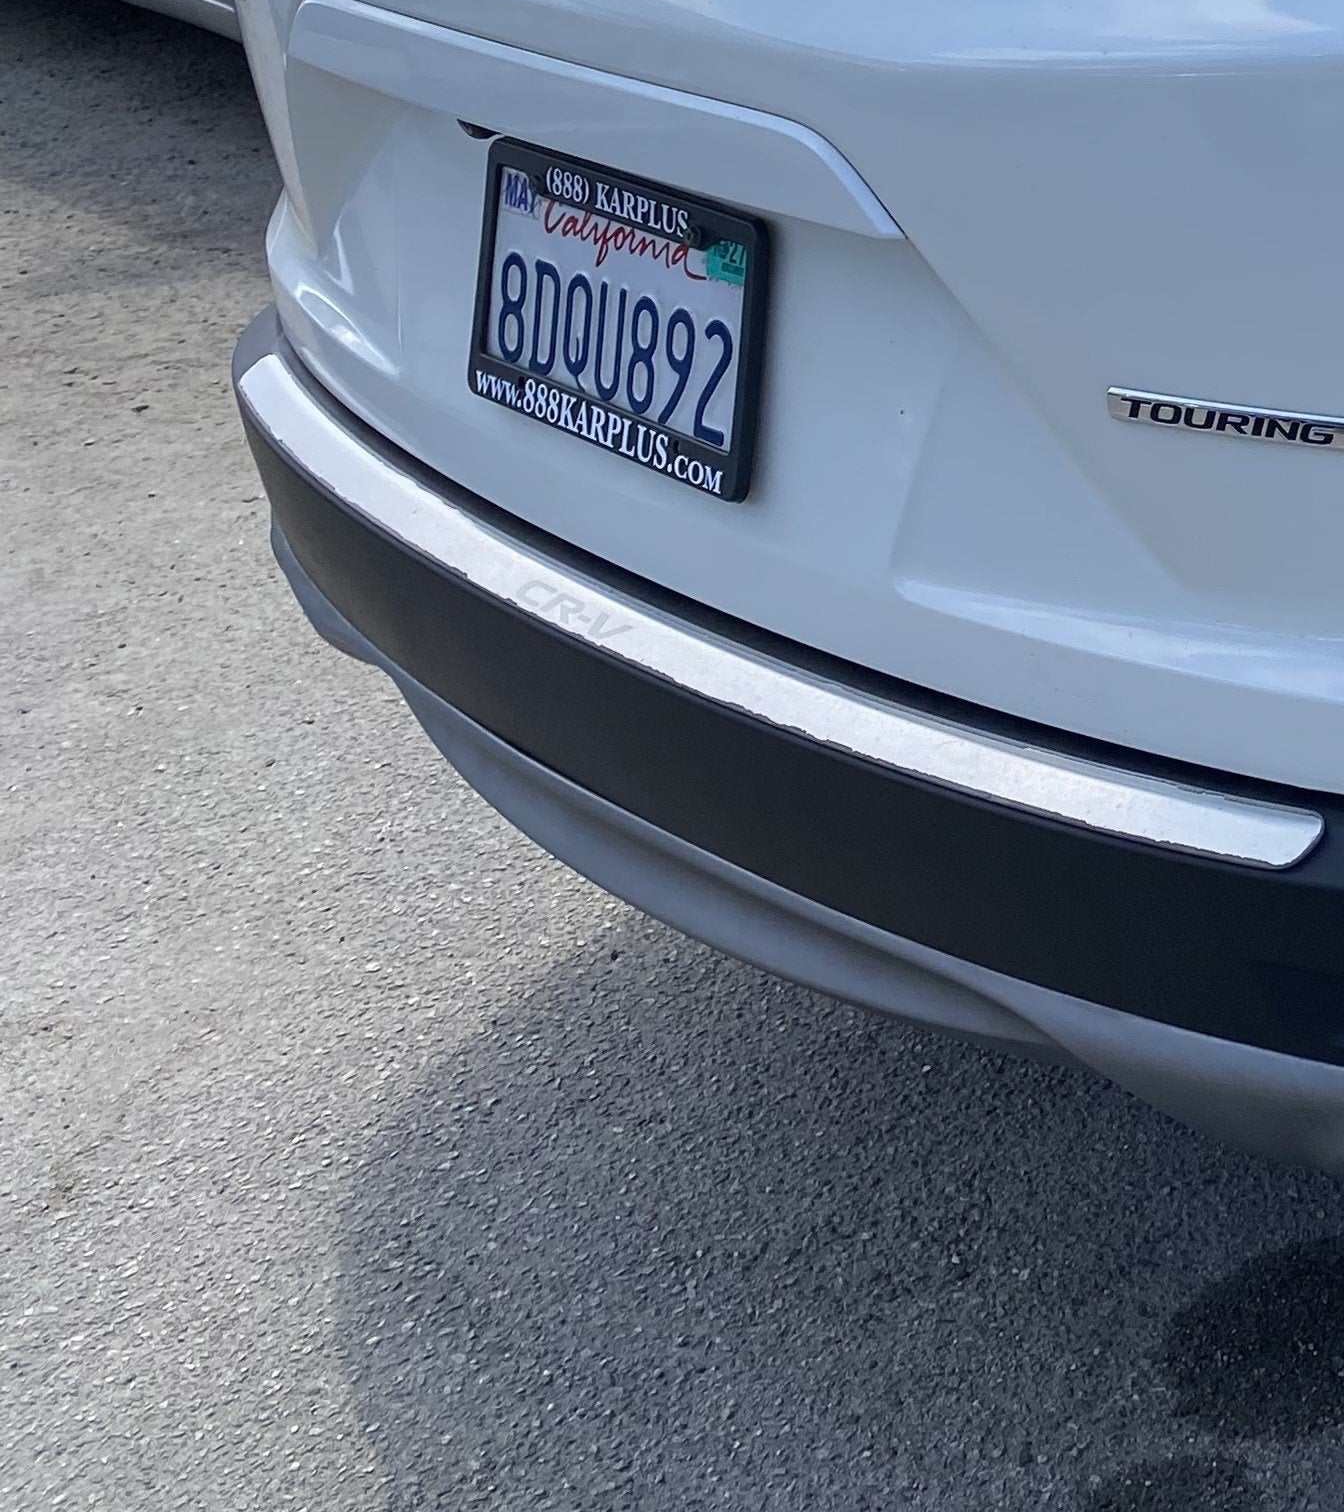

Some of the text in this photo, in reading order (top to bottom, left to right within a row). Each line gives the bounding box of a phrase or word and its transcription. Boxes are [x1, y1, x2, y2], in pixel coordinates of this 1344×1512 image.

[545, 166, 689, 239] (888) KARPLUS
[543, 199, 707, 281] California
[498, 251, 734, 448] 8DQU892
[1120, 396, 1335, 446] TOURING
[515, 579, 634, 639] CR-V
